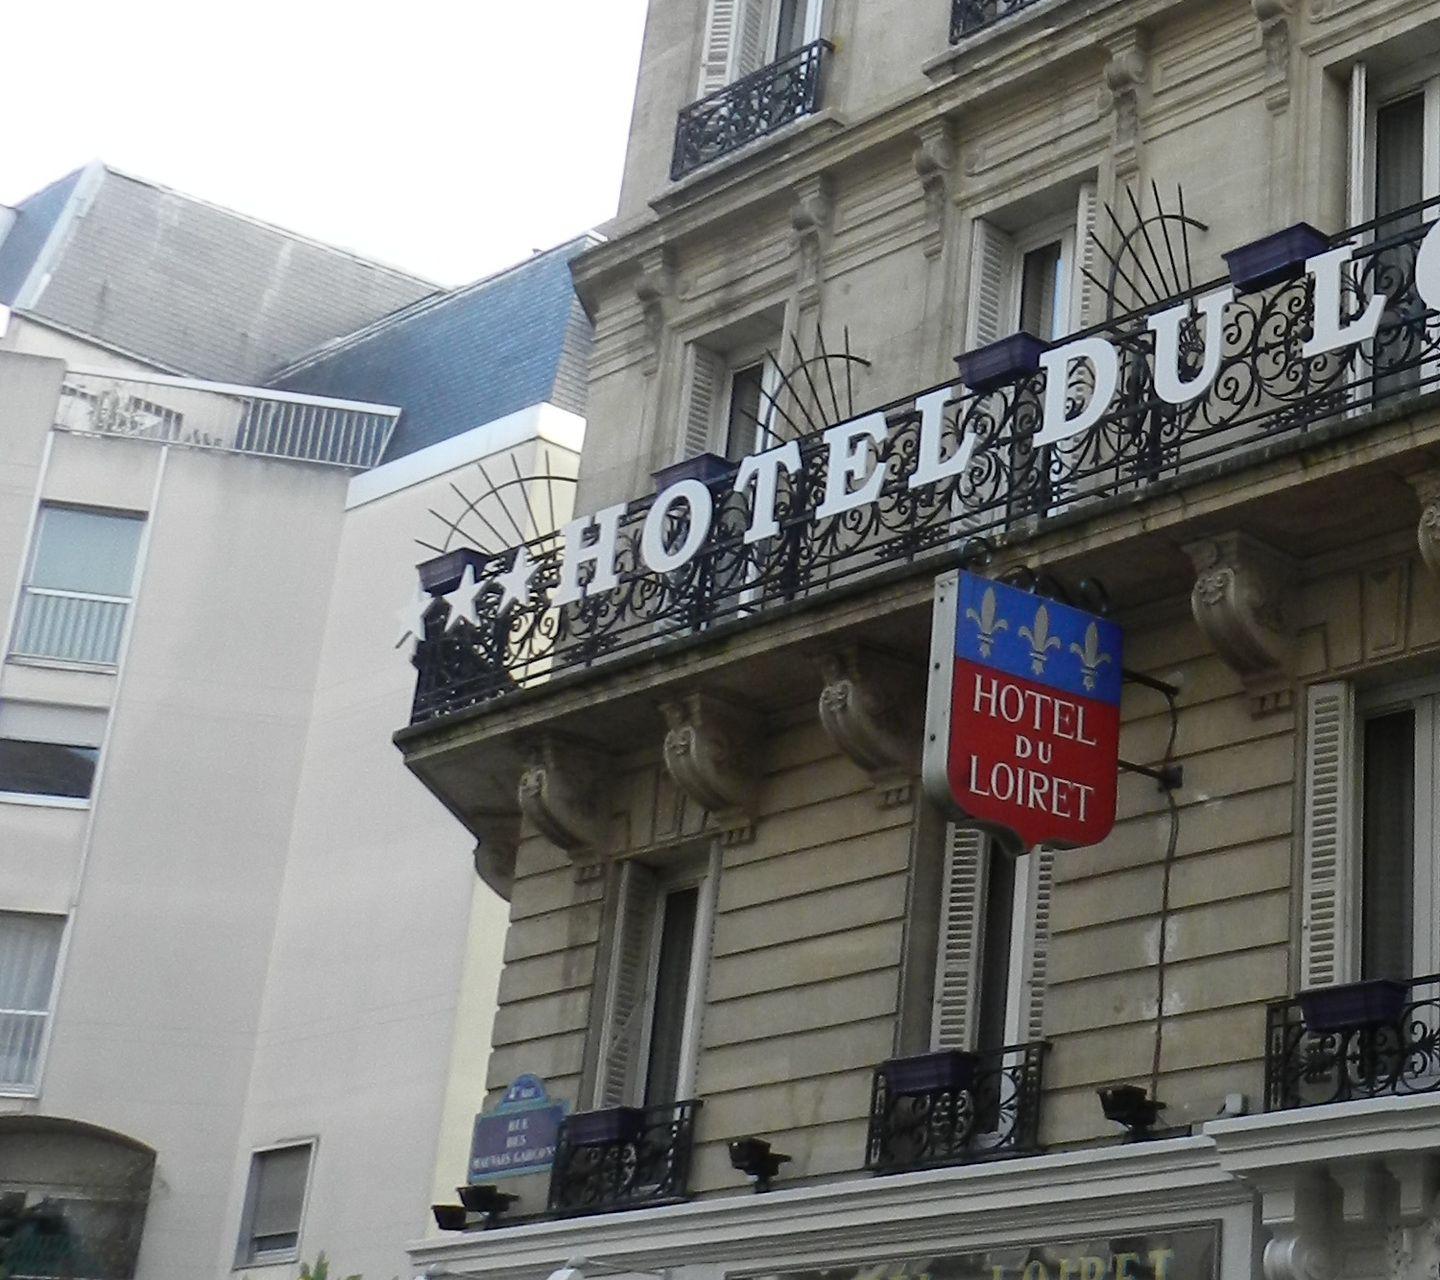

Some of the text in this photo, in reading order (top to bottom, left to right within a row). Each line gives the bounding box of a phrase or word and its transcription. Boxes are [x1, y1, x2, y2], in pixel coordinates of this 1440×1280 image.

[552, 385, 976, 608] HOTEL
[1033, 289, 1234, 448] DU
[973, 673, 1097, 746] HOTEL
[1015, 735, 1052, 764] DU
[969, 754, 1095, 822] LOIRET
